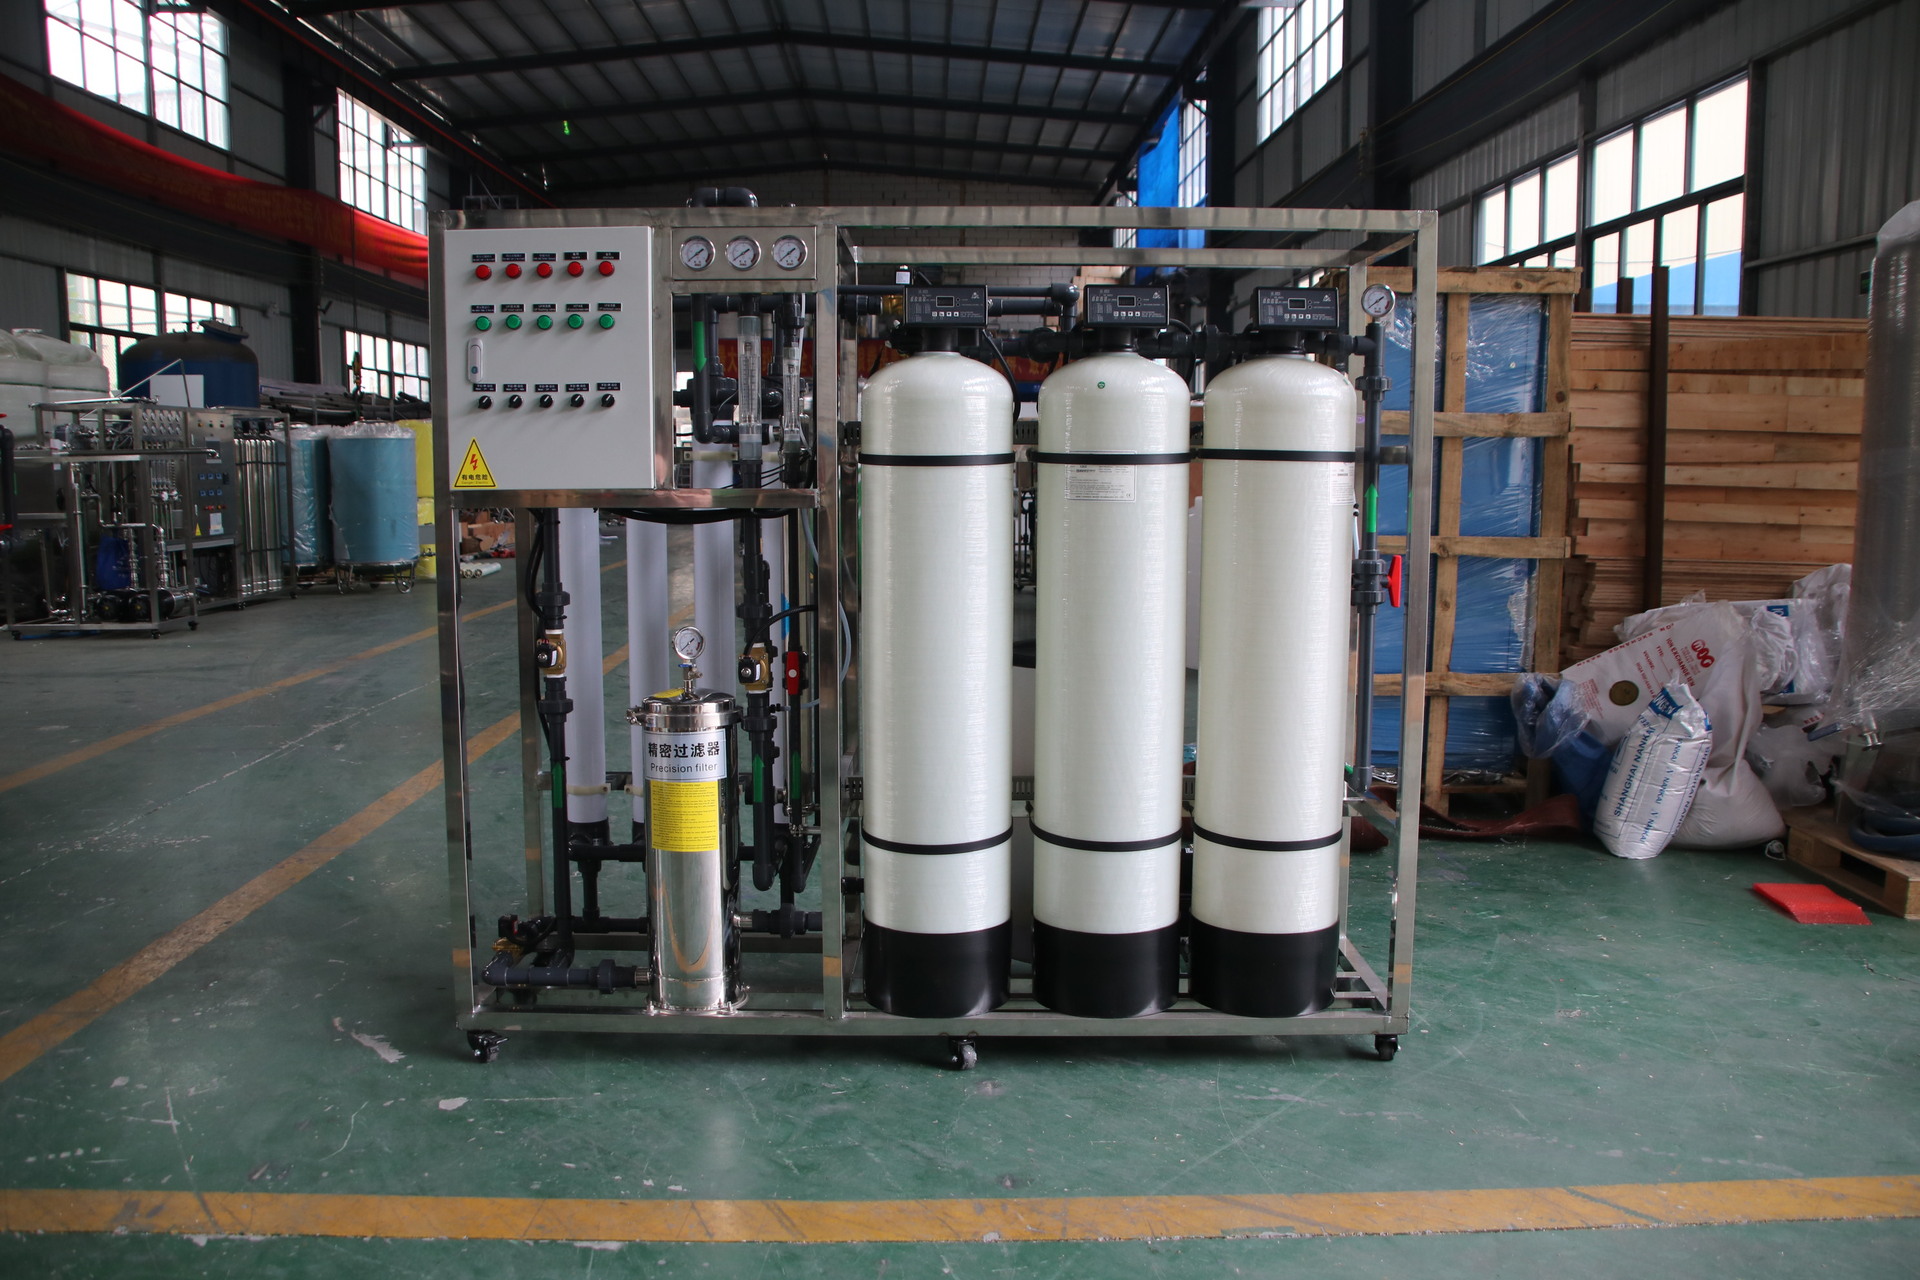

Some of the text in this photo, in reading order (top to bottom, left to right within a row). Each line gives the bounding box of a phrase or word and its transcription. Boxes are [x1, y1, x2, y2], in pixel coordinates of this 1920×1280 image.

[1670, 646, 1690, 677] EXCHANGE
[648, 741, 720, 758] 精密过滤器
[650, 762, 718, 773] Precision filter
[1613, 727, 1656, 817] SHANGHAI NANKAI
[1656, 776, 1670, 804] NANKAI
